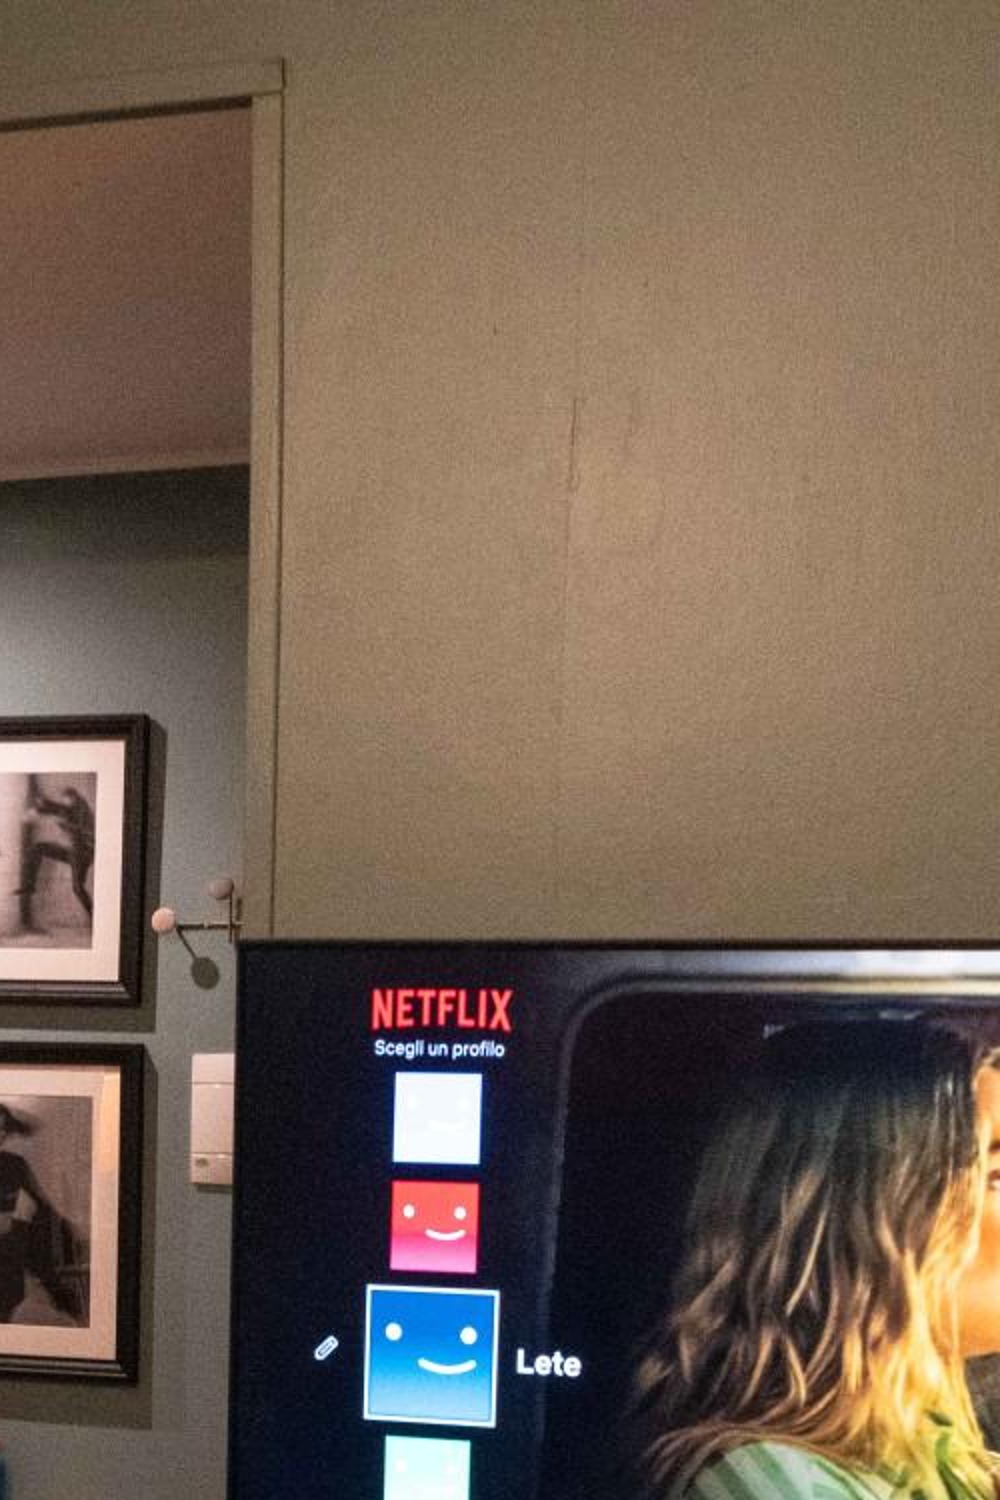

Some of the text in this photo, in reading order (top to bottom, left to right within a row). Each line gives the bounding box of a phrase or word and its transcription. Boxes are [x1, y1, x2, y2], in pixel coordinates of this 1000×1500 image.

[371, 987, 514, 1032] NETFLIX
[374, 1038, 505, 1060] Scegli un profilo
[516, 1347, 582, 1378] Lete
